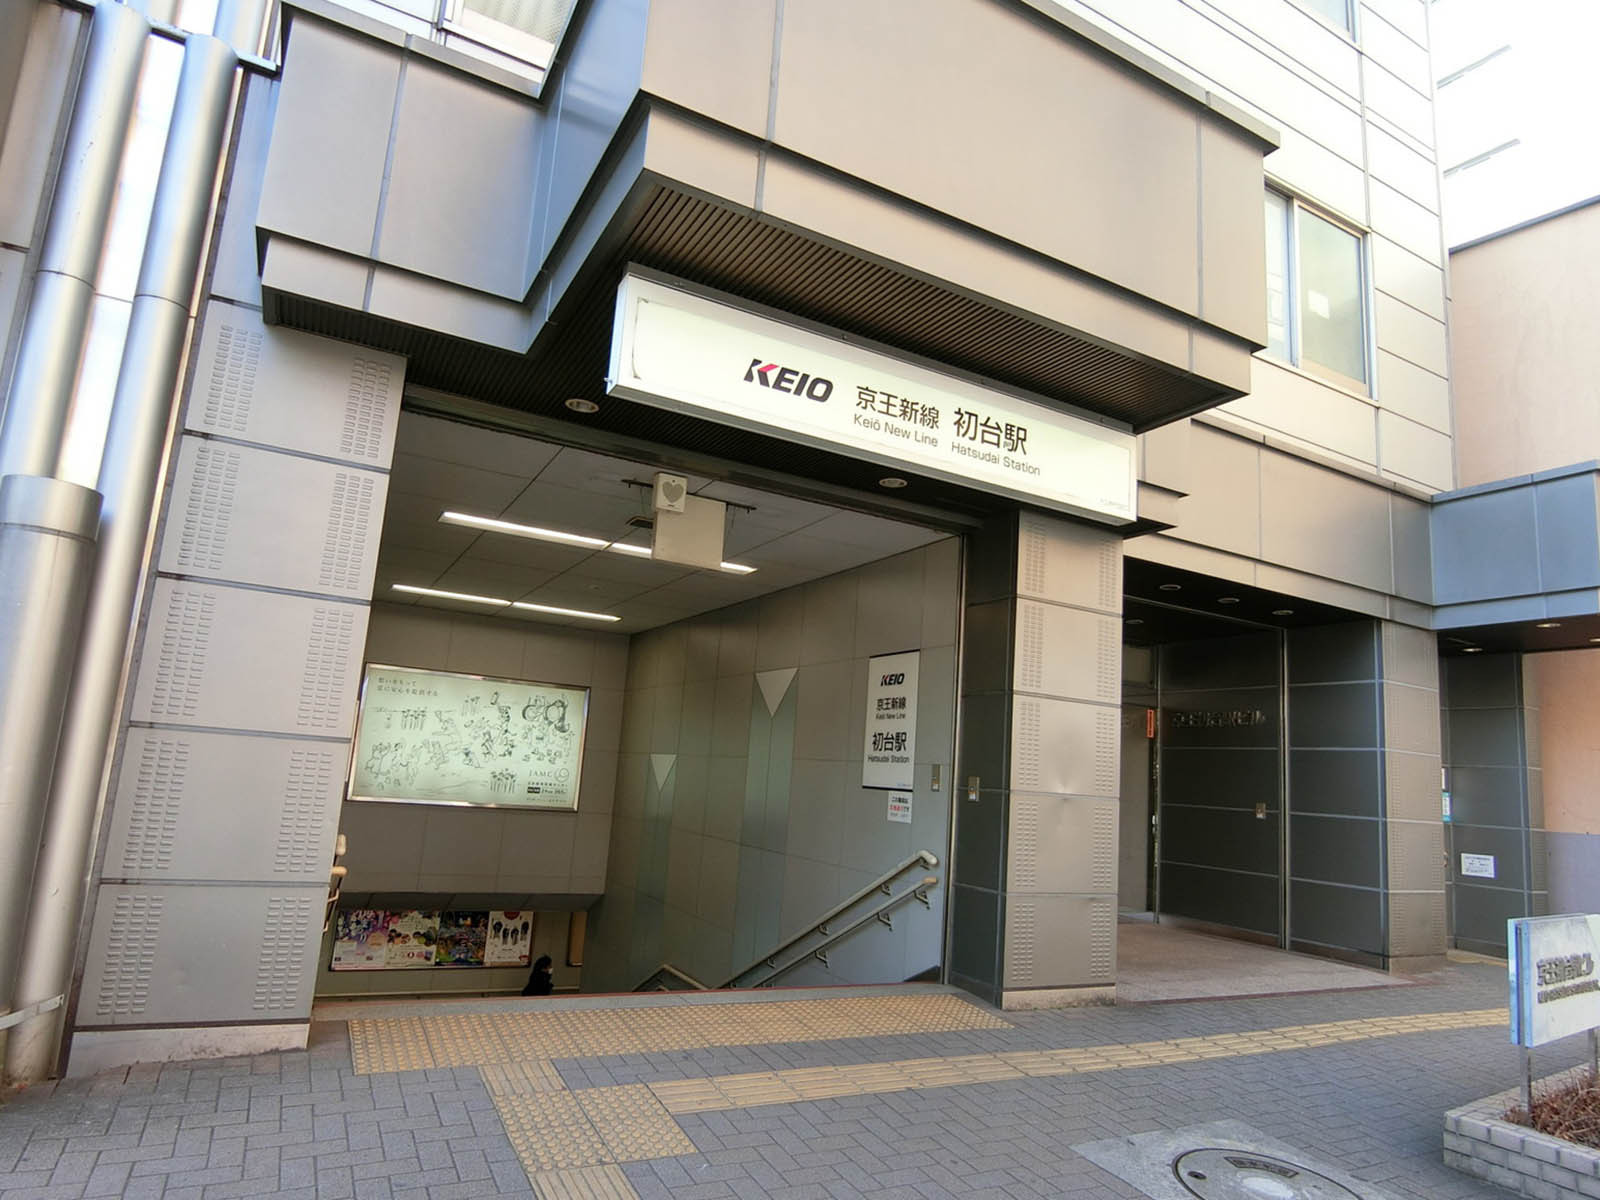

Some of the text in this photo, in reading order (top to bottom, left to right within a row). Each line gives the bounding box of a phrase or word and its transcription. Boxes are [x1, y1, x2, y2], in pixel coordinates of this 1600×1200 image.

[744, 358, 834, 403] KEIO
[856, 385, 1027, 456] 京王新線 初台駅
[884, 421, 911, 440] New
[914, 430, 939, 447] Line
[951, 441, 1000, 465] Hatsudai
[1002, 456, 1041, 476] Station
[880, 673, 905, 687] KEIO
[876, 696, 907, 711] 京王新線
[872, 731, 907, 752] 初台駅
